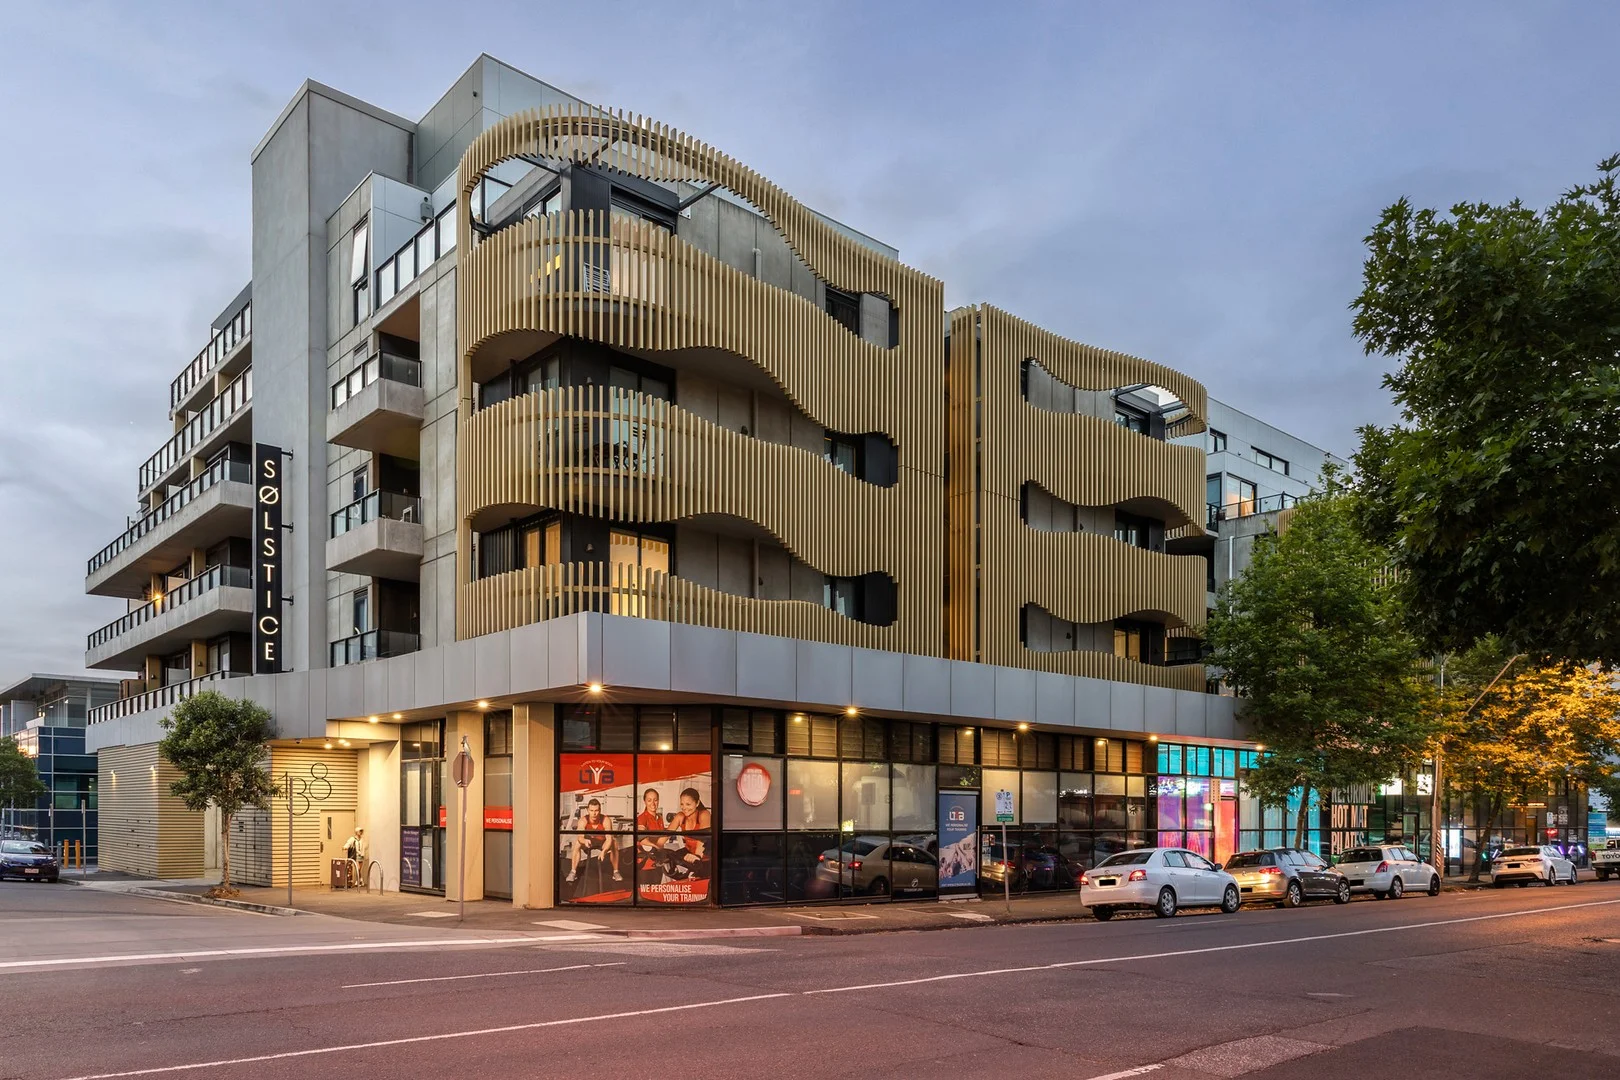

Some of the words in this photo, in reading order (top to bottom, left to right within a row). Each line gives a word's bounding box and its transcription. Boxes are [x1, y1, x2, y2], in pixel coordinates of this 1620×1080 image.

[259, 459, 279, 661] SØLSTICE
[274, 762, 332, 816] 138
[1331, 804, 1349, 828] HOT
[1350, 804, 1368, 828] MAT
[640, 884, 650, 892] WE
[651, 884, 692, 893] PERSONALISE
[662, 893, 679, 902] YOUR
